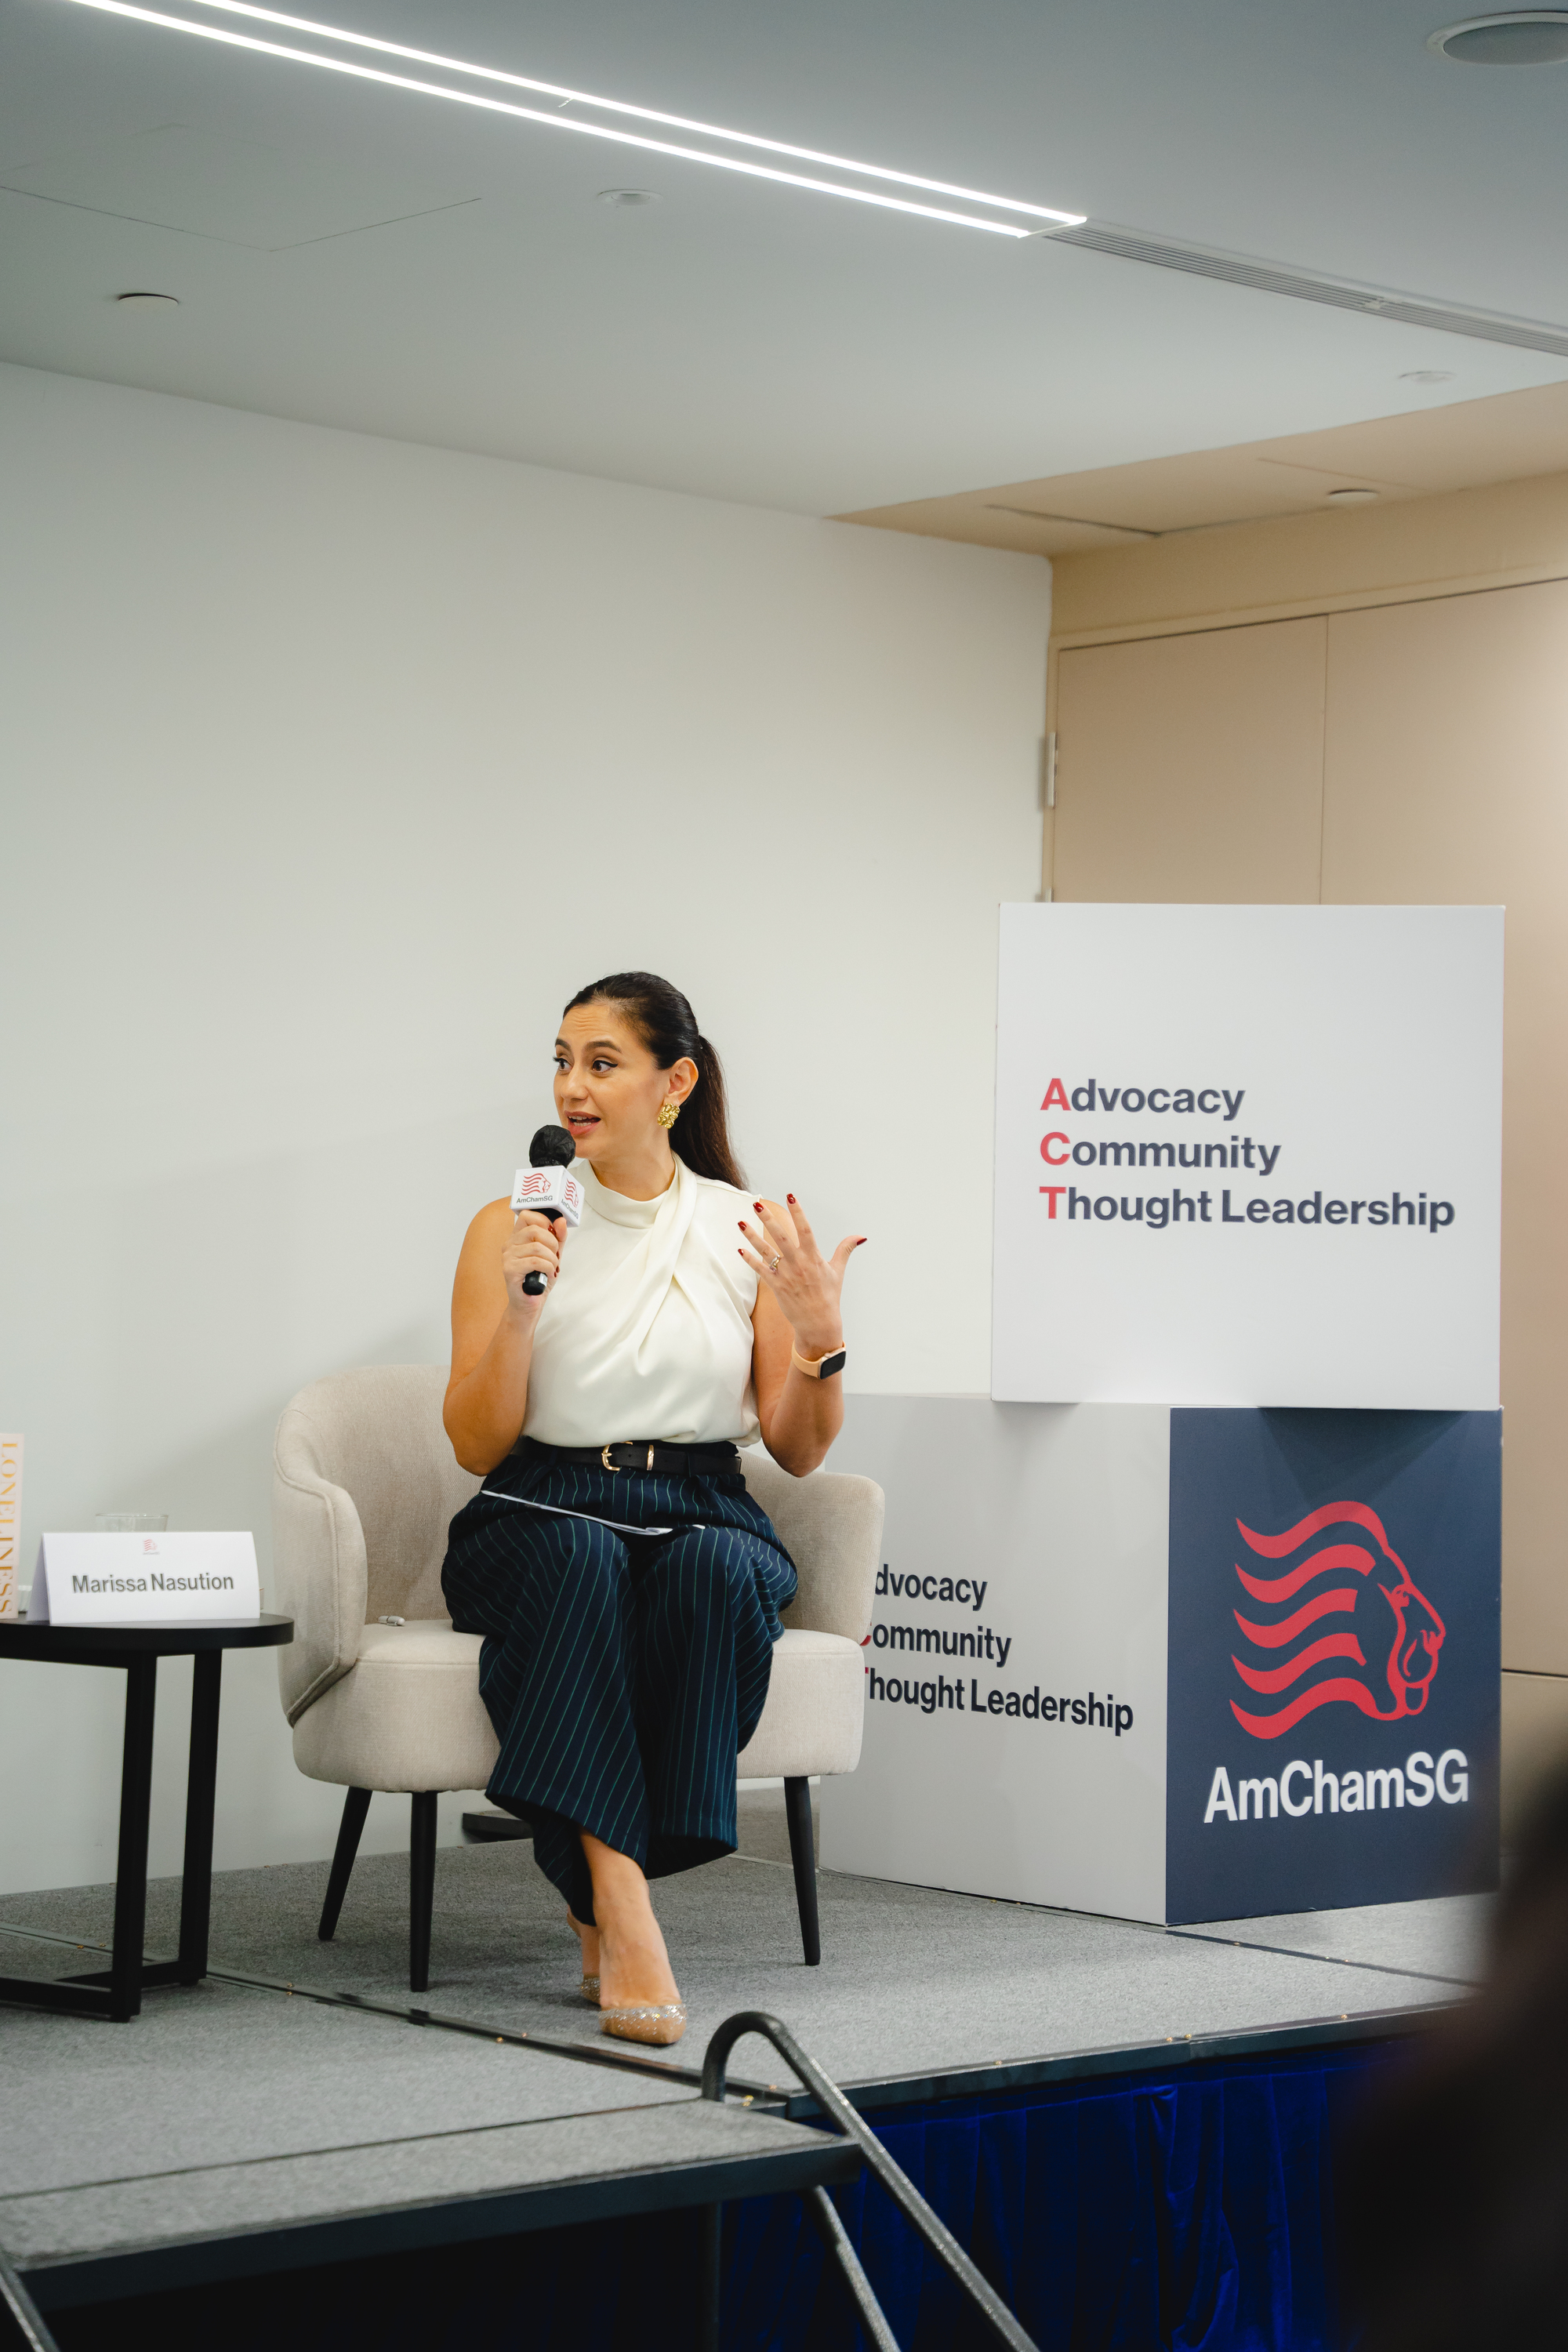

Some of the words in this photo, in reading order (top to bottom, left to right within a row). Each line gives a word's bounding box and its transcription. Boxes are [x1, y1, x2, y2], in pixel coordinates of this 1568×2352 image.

[1040, 1077, 1246, 1121] Advocacy
[1040, 1131, 1282, 1176] Community
[561, 1199, 579, 1219] AmChamSG
[1039, 1185, 1213, 1229] Thought
[1221, 1189, 1456, 1233] Leadership
[0, 1443, 17, 1613] LONELINESS
[72, 1574, 147, 1593] Marissa
[151, 1572, 234, 1592] Nasution
[875, 1563, 988, 1611] dvocacy
[859, 1621, 1012, 1668] ommunity
[865, 1666, 965, 1714] hought
[971, 1678, 1134, 1737] Leadership
[1203, 1748, 1469, 1824] AmChamSG
